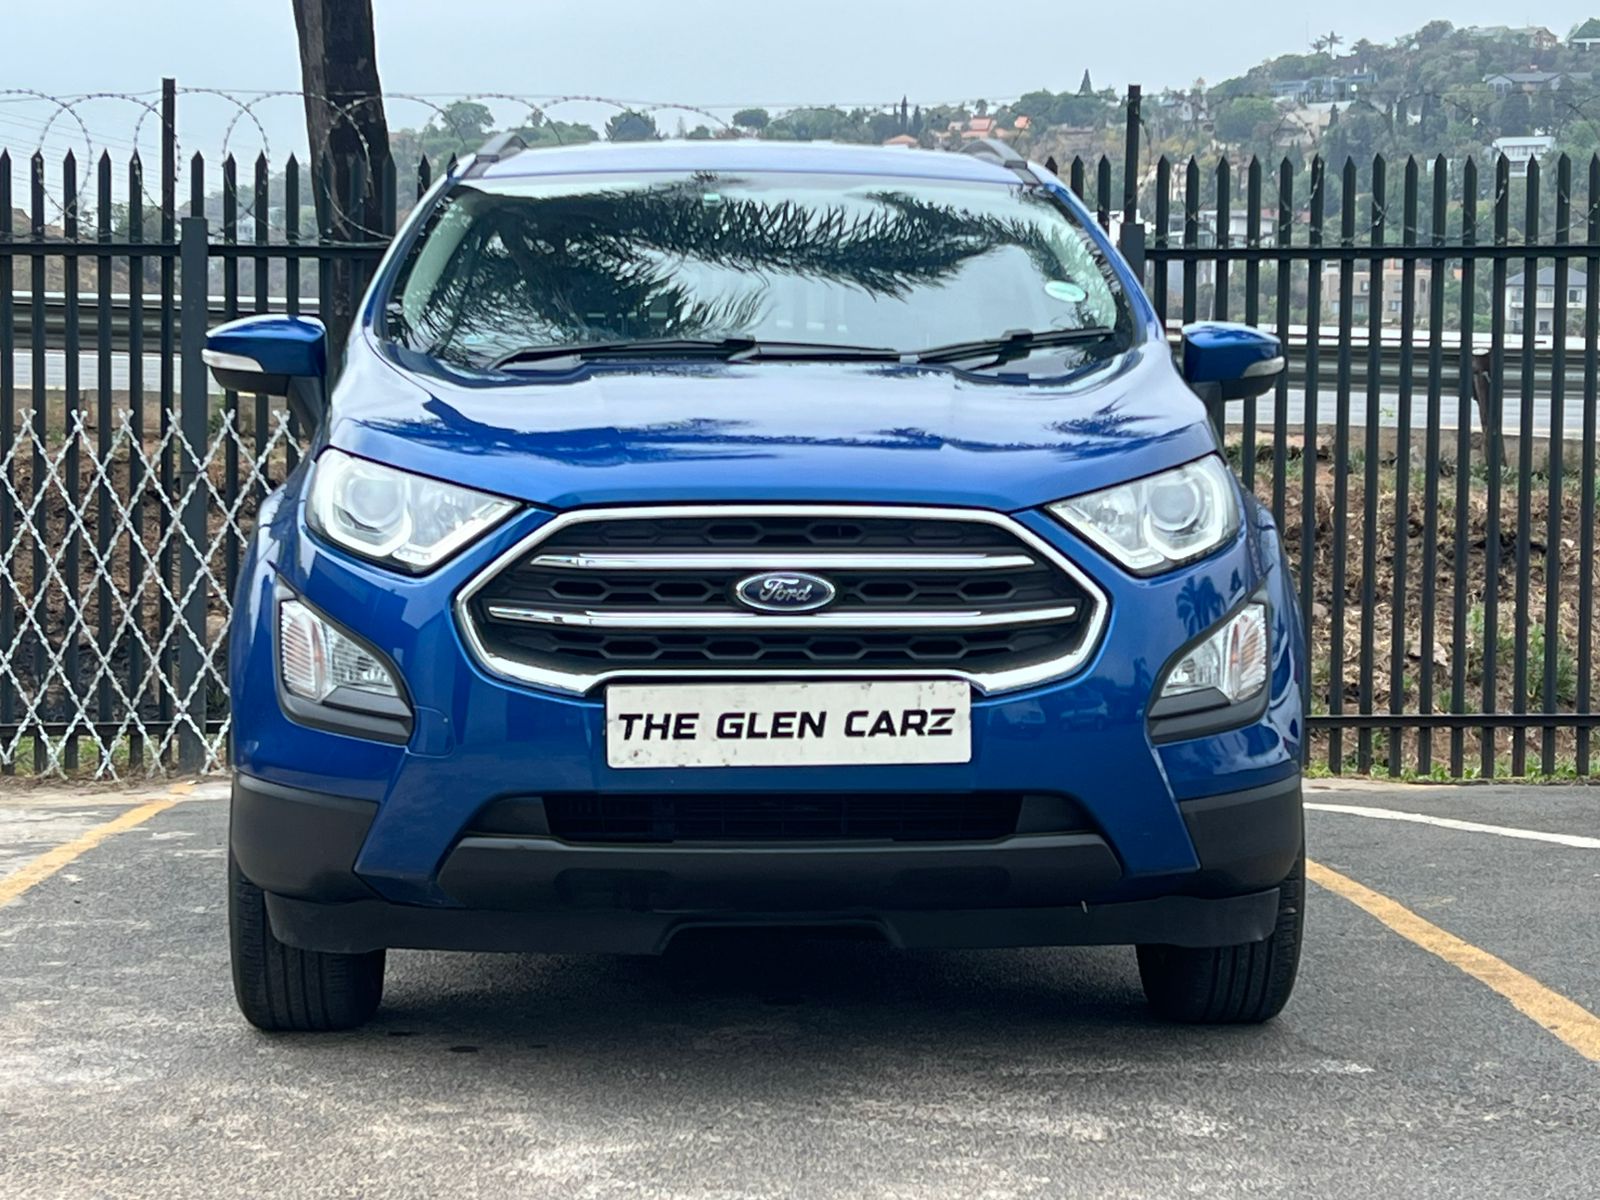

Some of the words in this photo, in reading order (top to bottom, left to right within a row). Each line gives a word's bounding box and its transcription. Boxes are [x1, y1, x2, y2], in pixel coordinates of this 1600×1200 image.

[759, 578, 813, 601] Ford
[618, 712, 700, 740] THE
[716, 710, 827, 739] GLEN
[844, 708, 956, 738] CARZ
